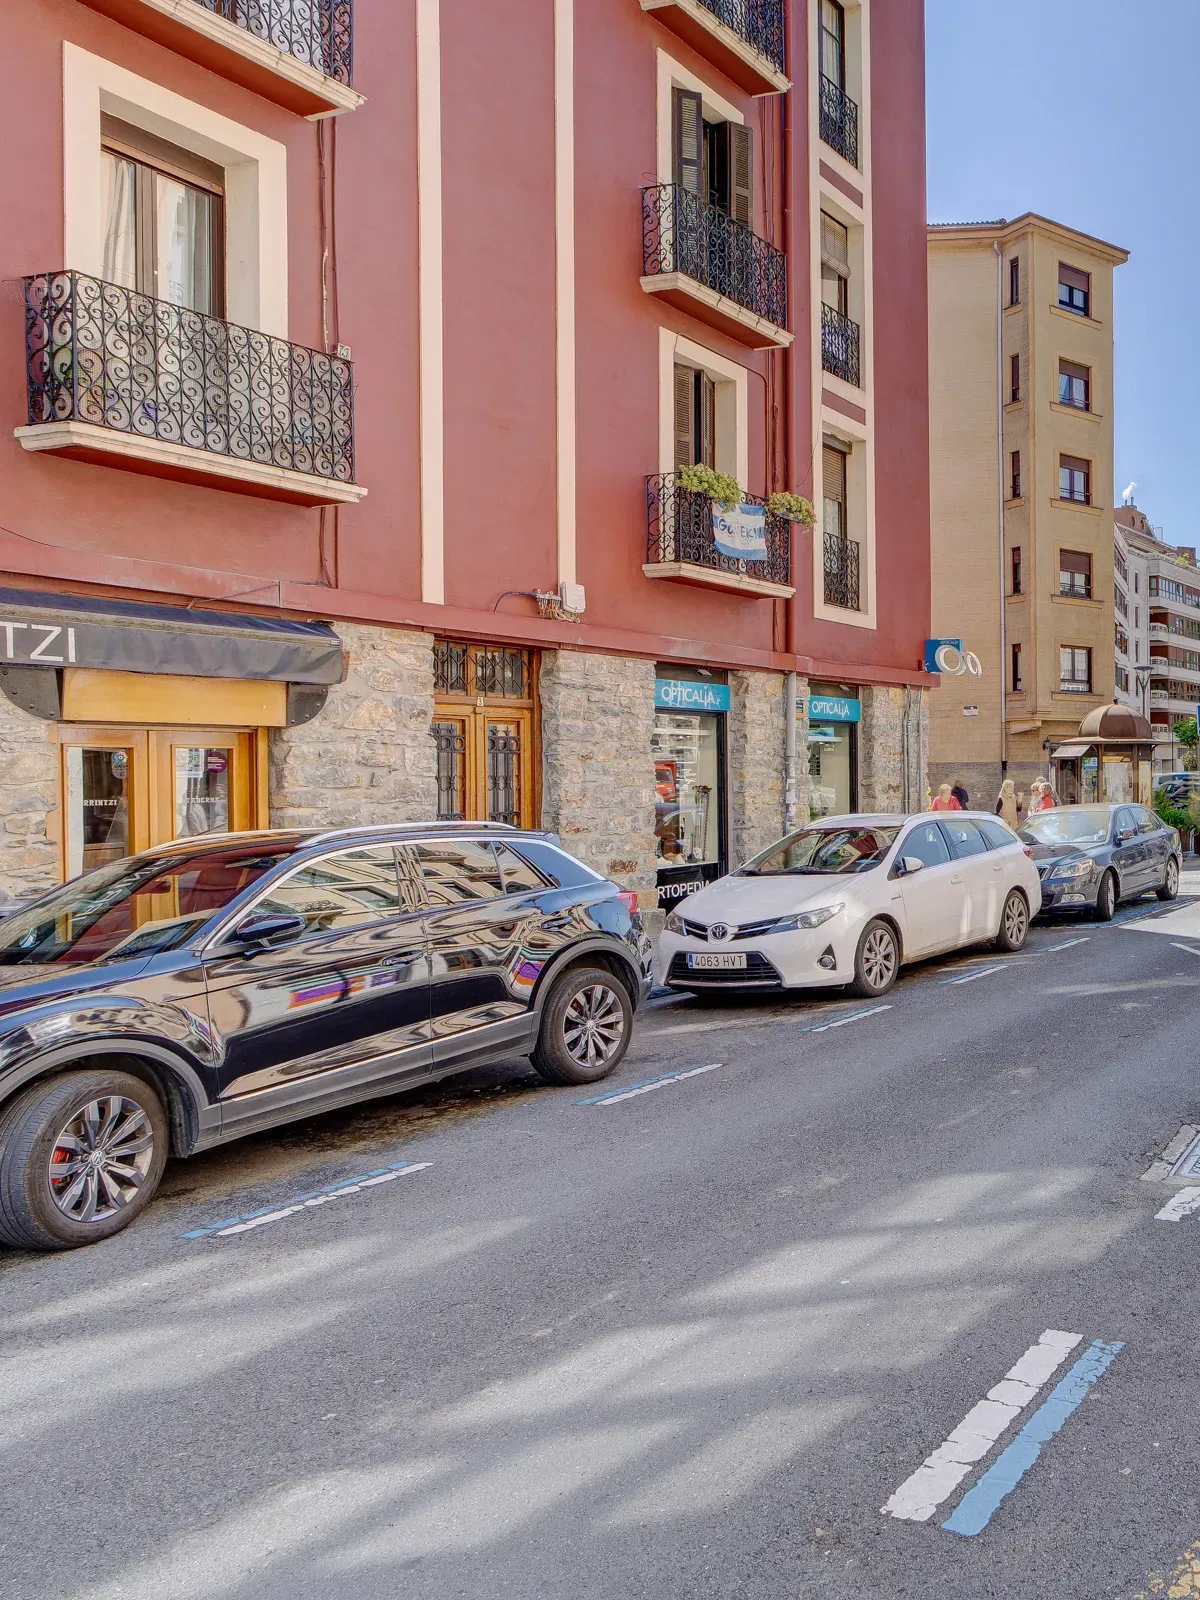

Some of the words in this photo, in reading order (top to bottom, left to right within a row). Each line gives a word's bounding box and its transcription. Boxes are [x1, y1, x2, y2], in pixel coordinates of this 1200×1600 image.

[0, 620, 77, 663] TZI
[811, 699, 850, 717] OPTICALIA
[694, 956, 720, 967] 4063
[723, 955, 744, 966] HVT
